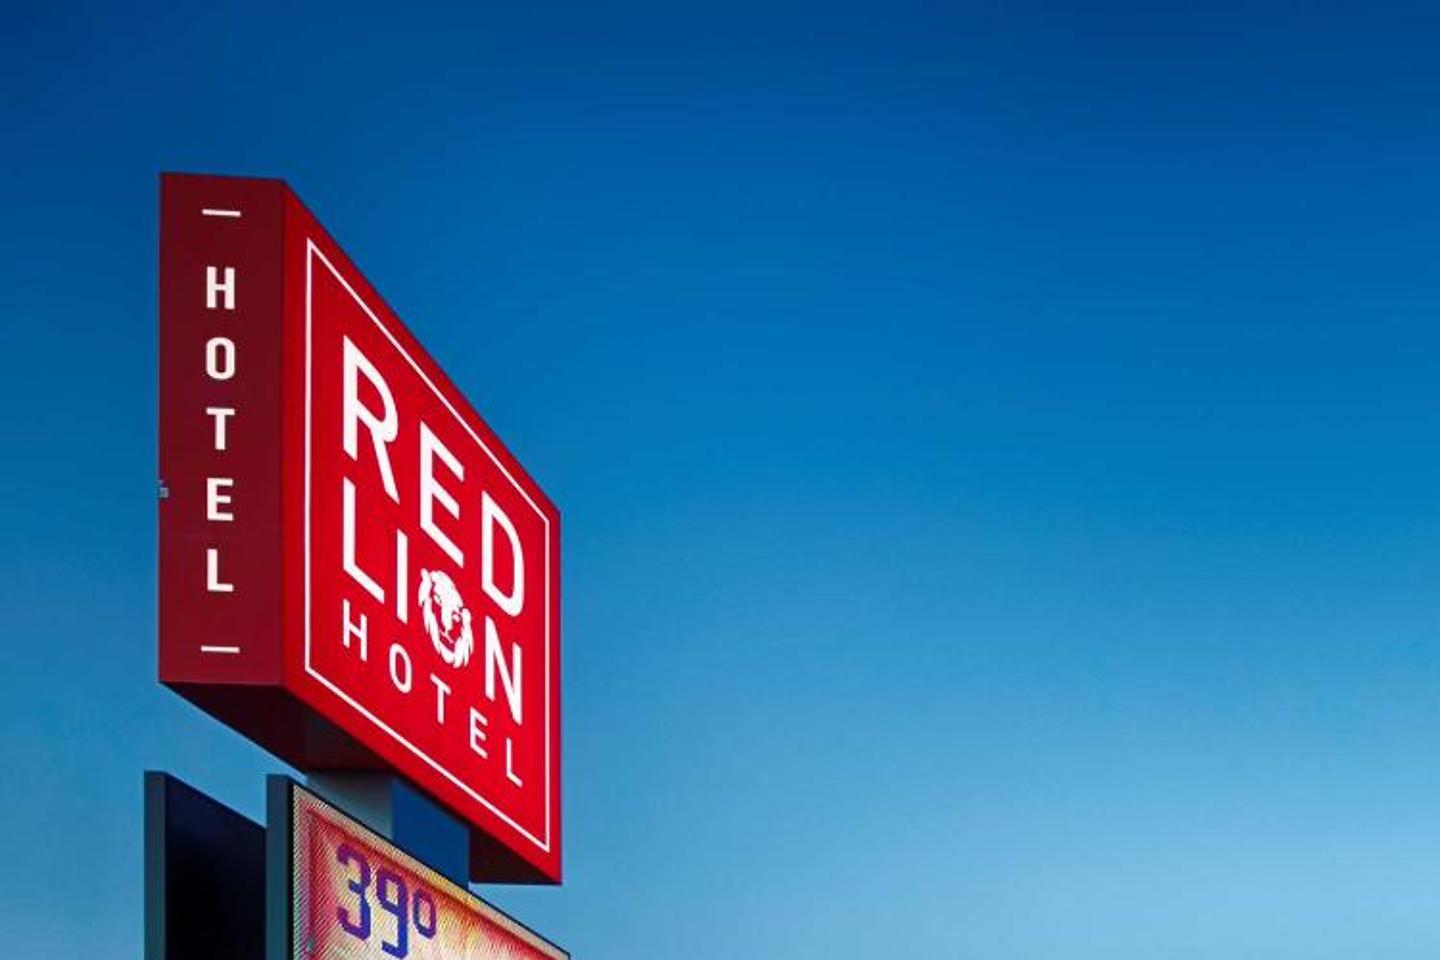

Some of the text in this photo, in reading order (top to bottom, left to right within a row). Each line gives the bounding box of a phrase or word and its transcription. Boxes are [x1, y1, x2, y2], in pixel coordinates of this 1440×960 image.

[205, 265, 236, 593] HOTEL
[342, 334, 525, 618] RED
[342, 598, 523, 788] HOTEL
